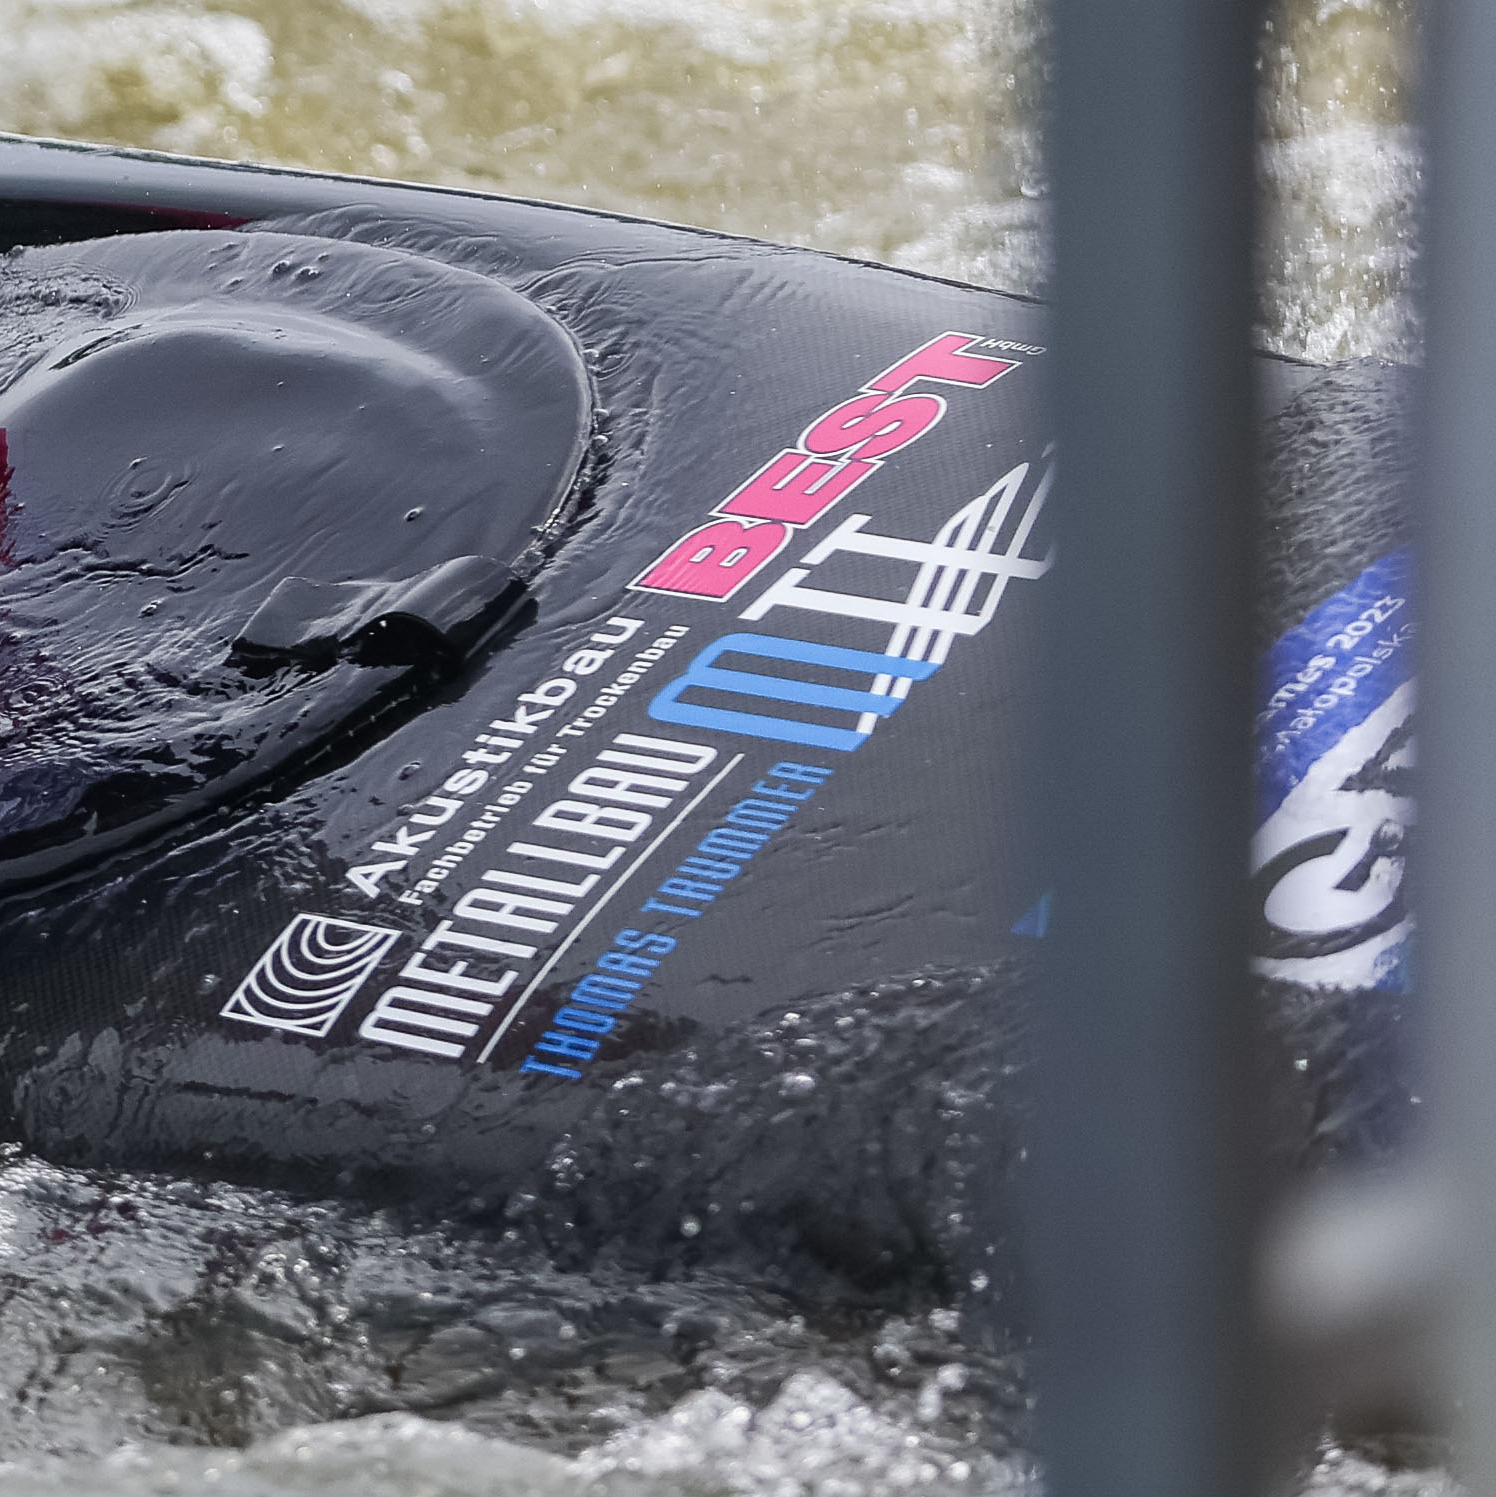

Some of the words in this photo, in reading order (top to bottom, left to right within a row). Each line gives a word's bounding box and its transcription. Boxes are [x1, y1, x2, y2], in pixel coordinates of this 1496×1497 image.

[627, 330, 1023, 602] BEST
[979, 338, 1047, 356] GmbH
[345, 616, 645, 899] Akustikbau
[1325, 595, 1406, 650] 2023
[358, 734, 718, 1057] METALLBAU
[398, 780, 533, 906] Fachbetrieb
[523, 743, 567, 775] für
[556, 624, 691, 737] Trockenbau
[520, 928, 677, 1079] THOMAS
[642, 761, 833, 919] TRUMMER
